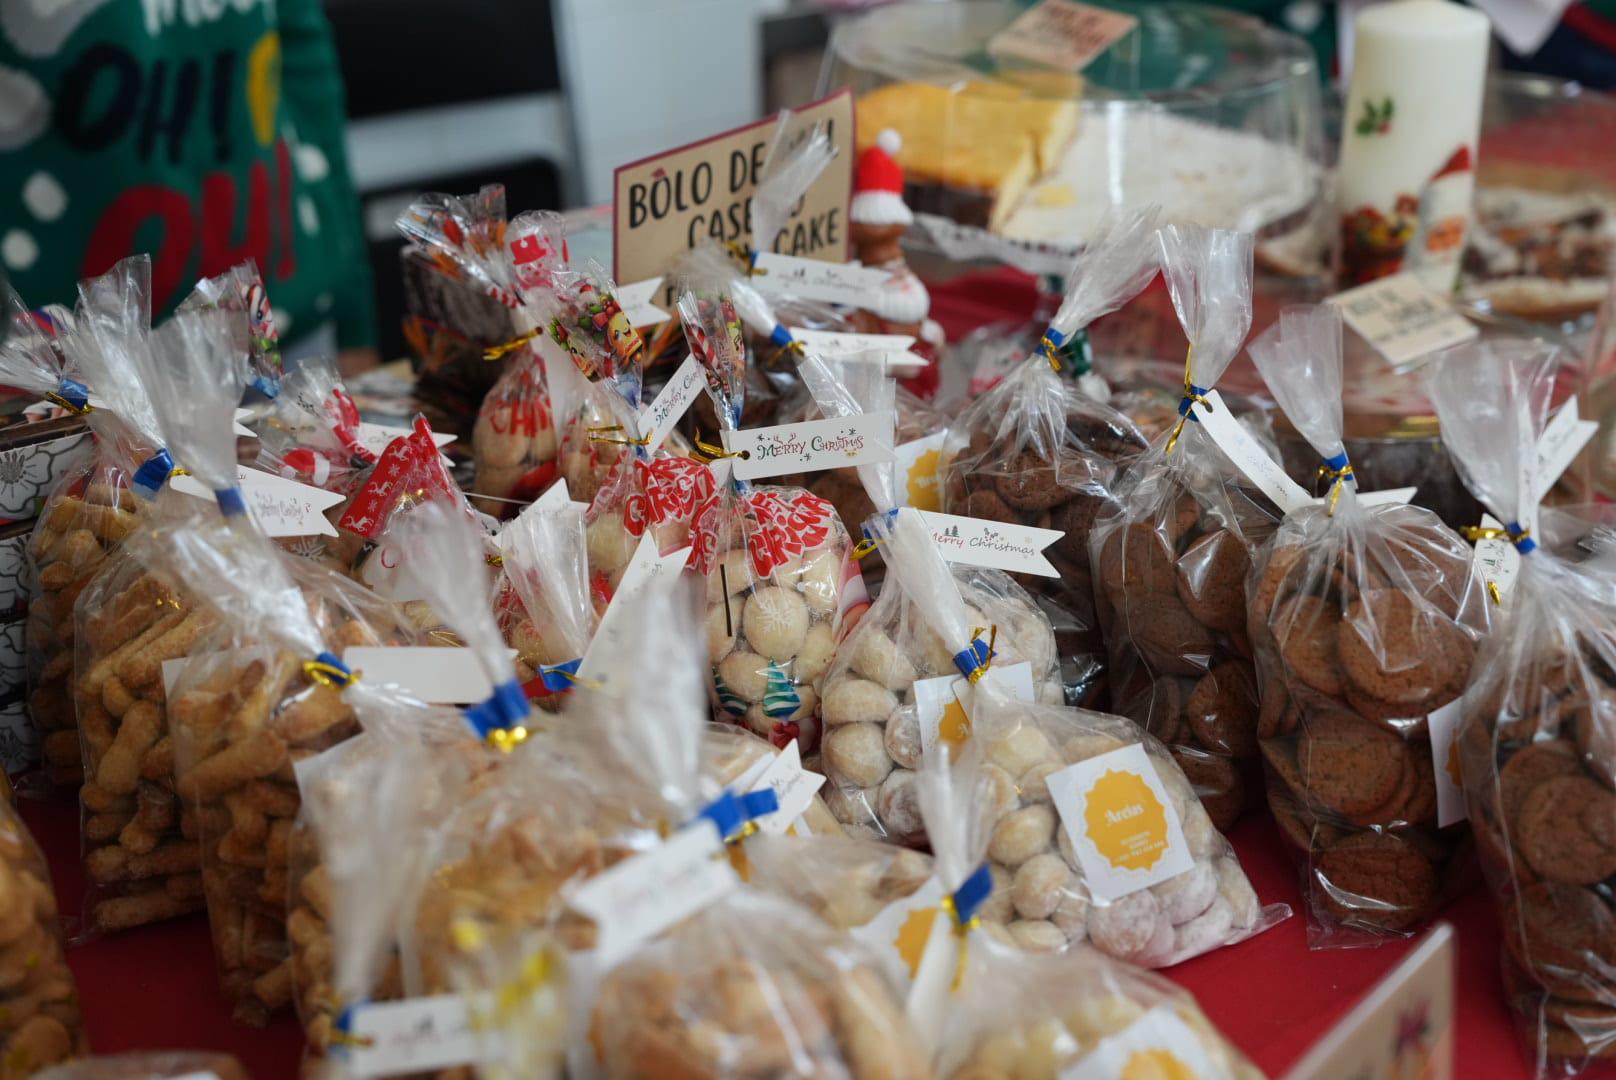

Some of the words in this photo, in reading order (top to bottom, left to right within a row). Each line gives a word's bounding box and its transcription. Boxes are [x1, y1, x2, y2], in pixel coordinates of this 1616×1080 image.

[729, 141, 765, 194] DE
[774, 207, 839, 257] CAKE
[969, 537, 1034, 556] Christmas
